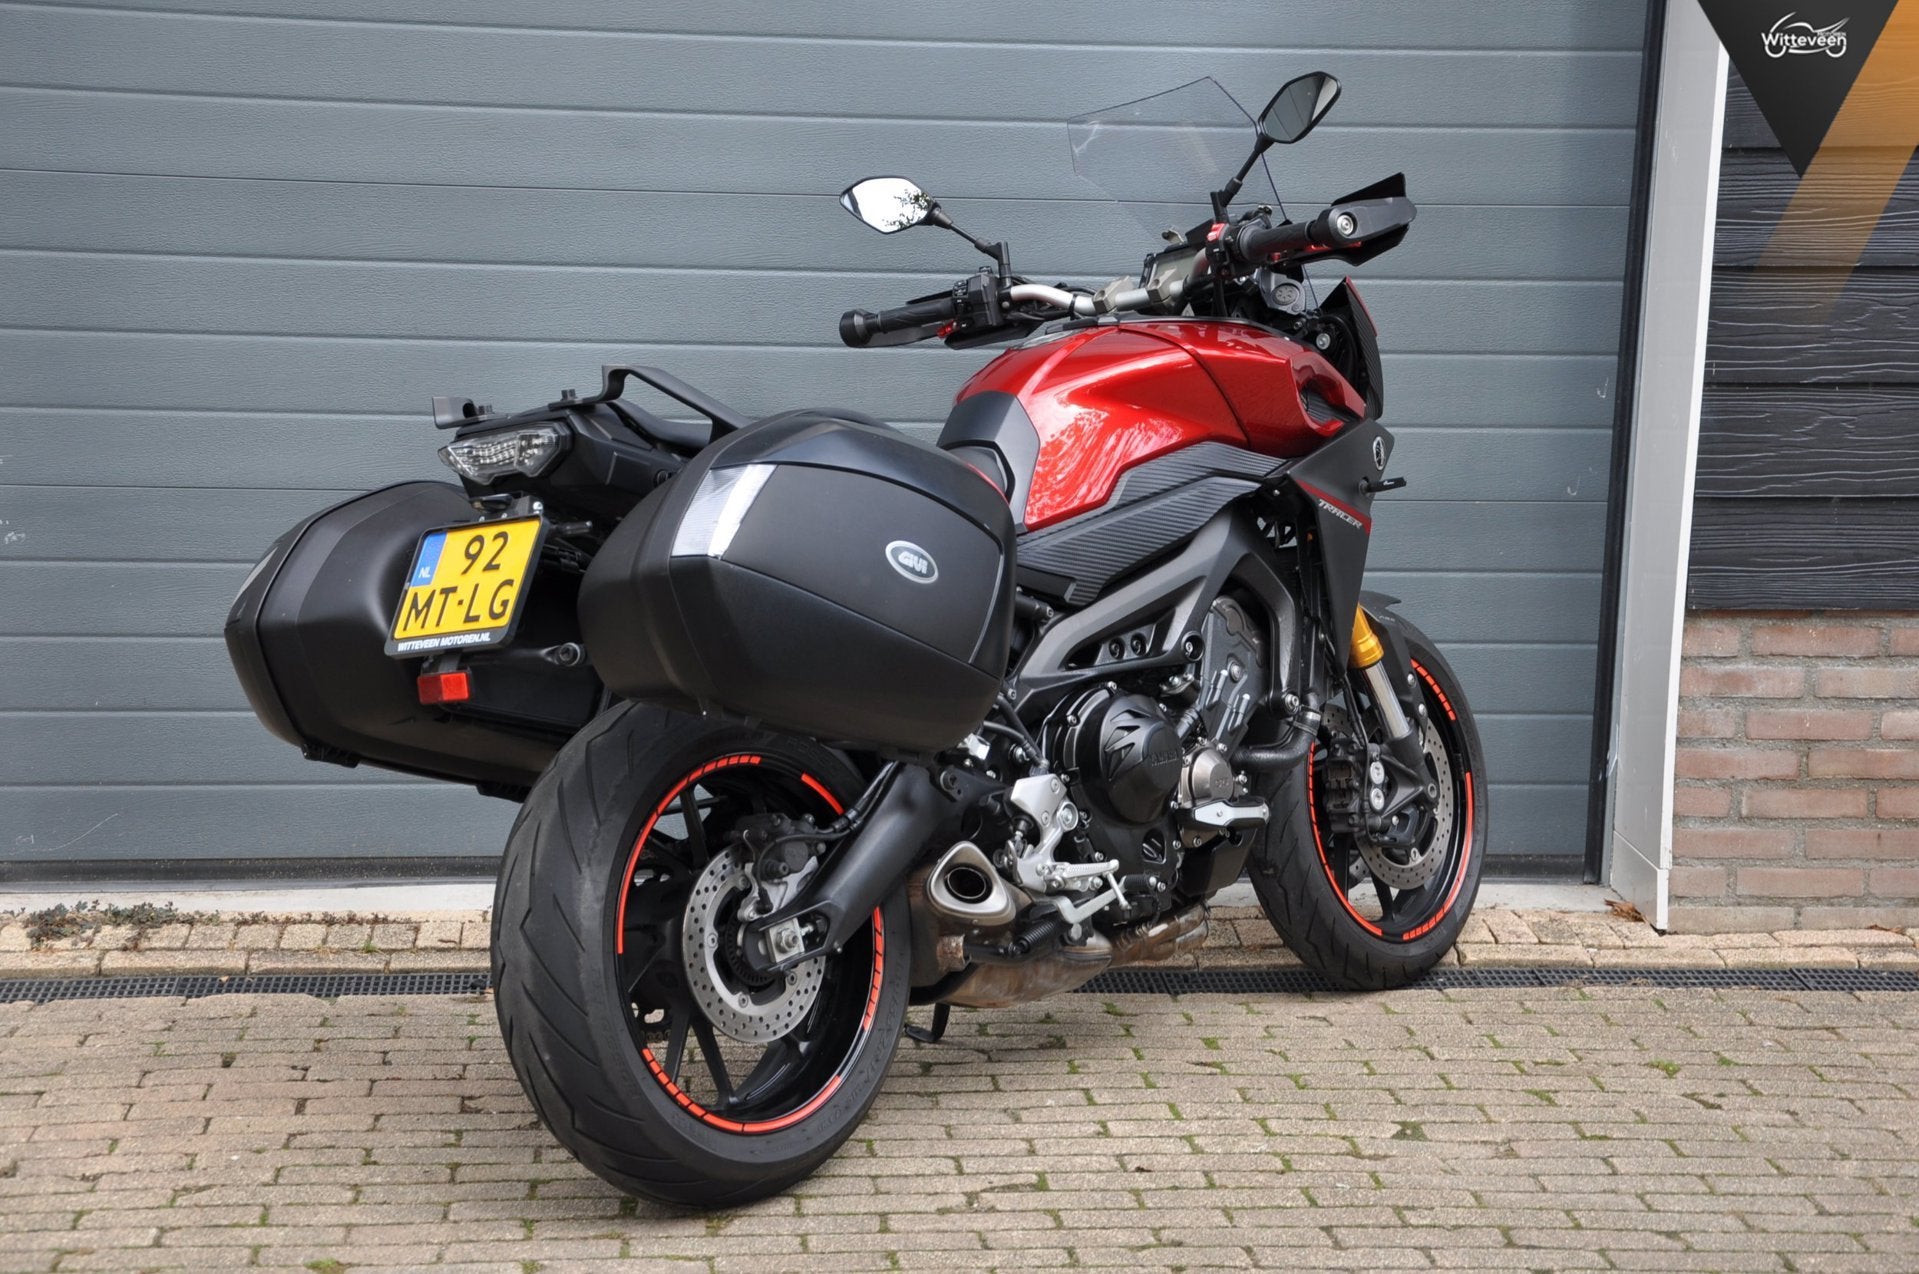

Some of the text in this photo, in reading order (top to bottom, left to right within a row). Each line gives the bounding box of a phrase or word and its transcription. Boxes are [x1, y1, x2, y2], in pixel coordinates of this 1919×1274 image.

[1318, 499, 1362, 529] TRACER
[461, 531, 509, 575] 92
[418, 567, 432, 578] NL
[397, 632, 491, 652] WITTEVEEN MOTOREN.NL
